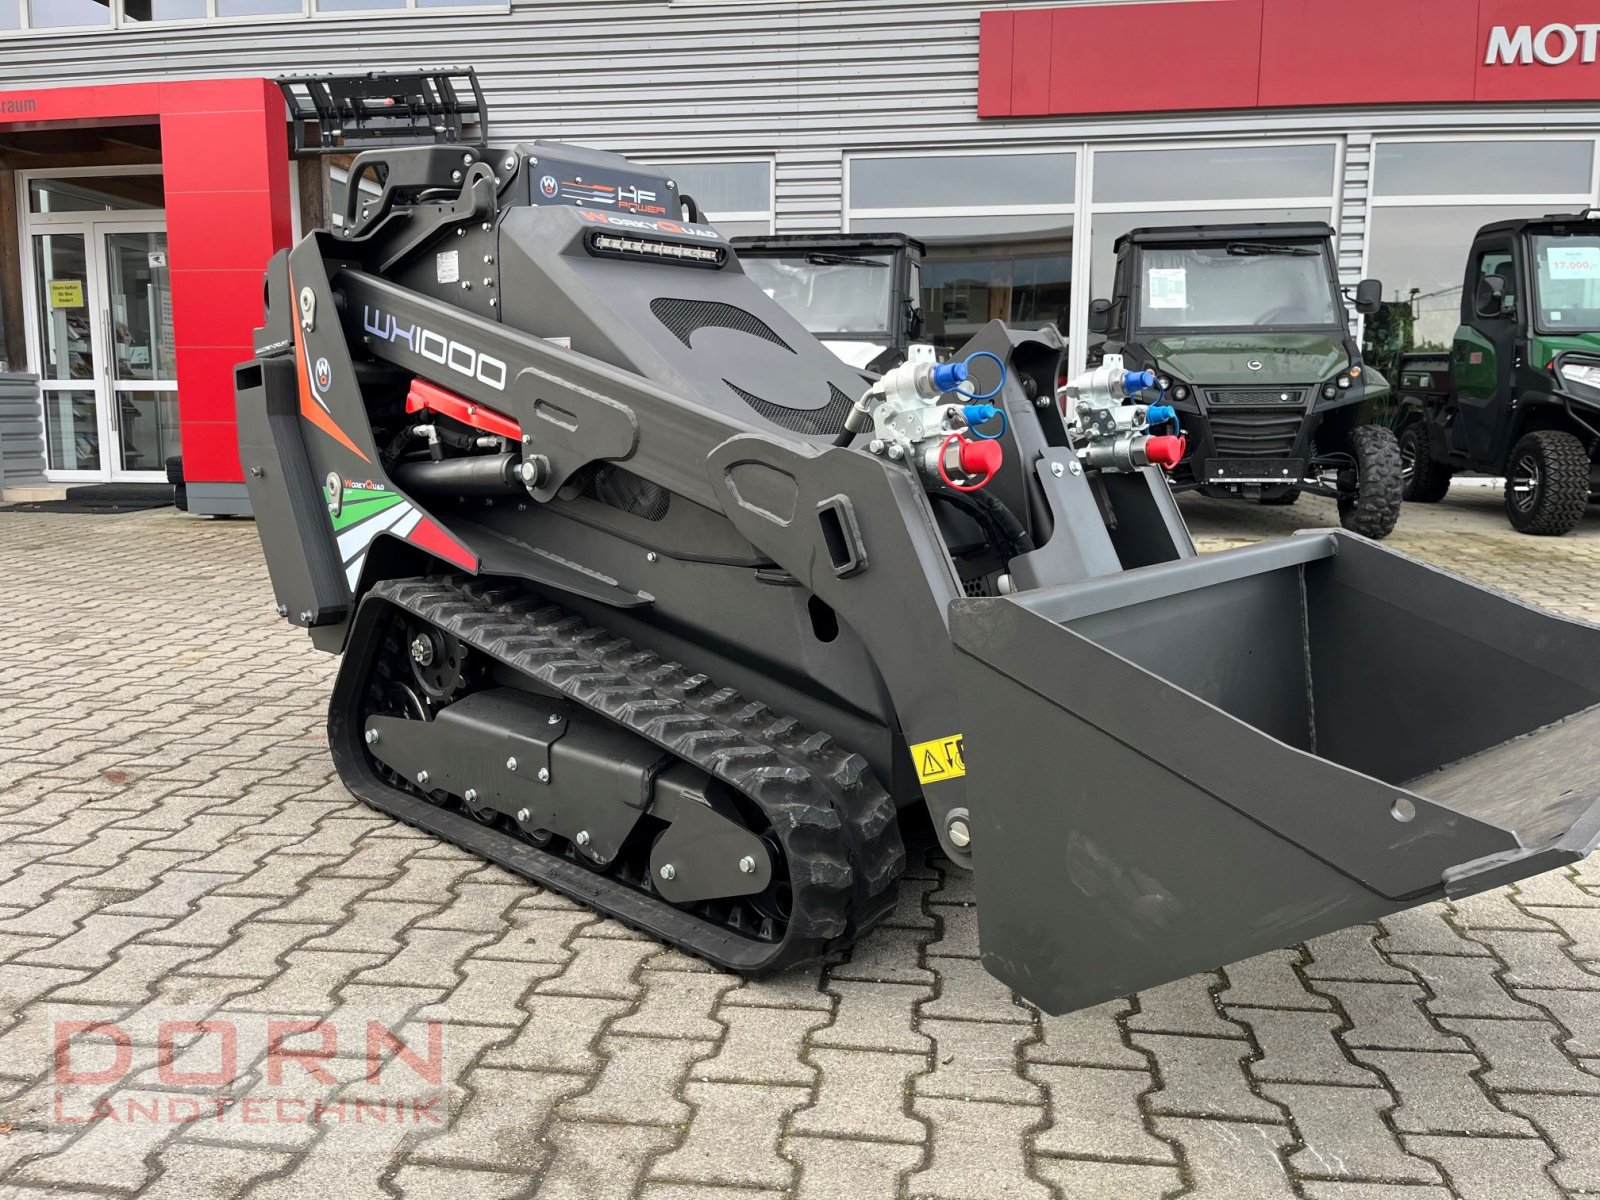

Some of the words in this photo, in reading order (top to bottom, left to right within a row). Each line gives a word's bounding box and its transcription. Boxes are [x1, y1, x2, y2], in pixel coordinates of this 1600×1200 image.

[1485, 23, 1600, 65] MOT
[0, 99, 37, 113] raum
[617, 187, 657, 204] HF
[618, 202, 666, 214] POWER
